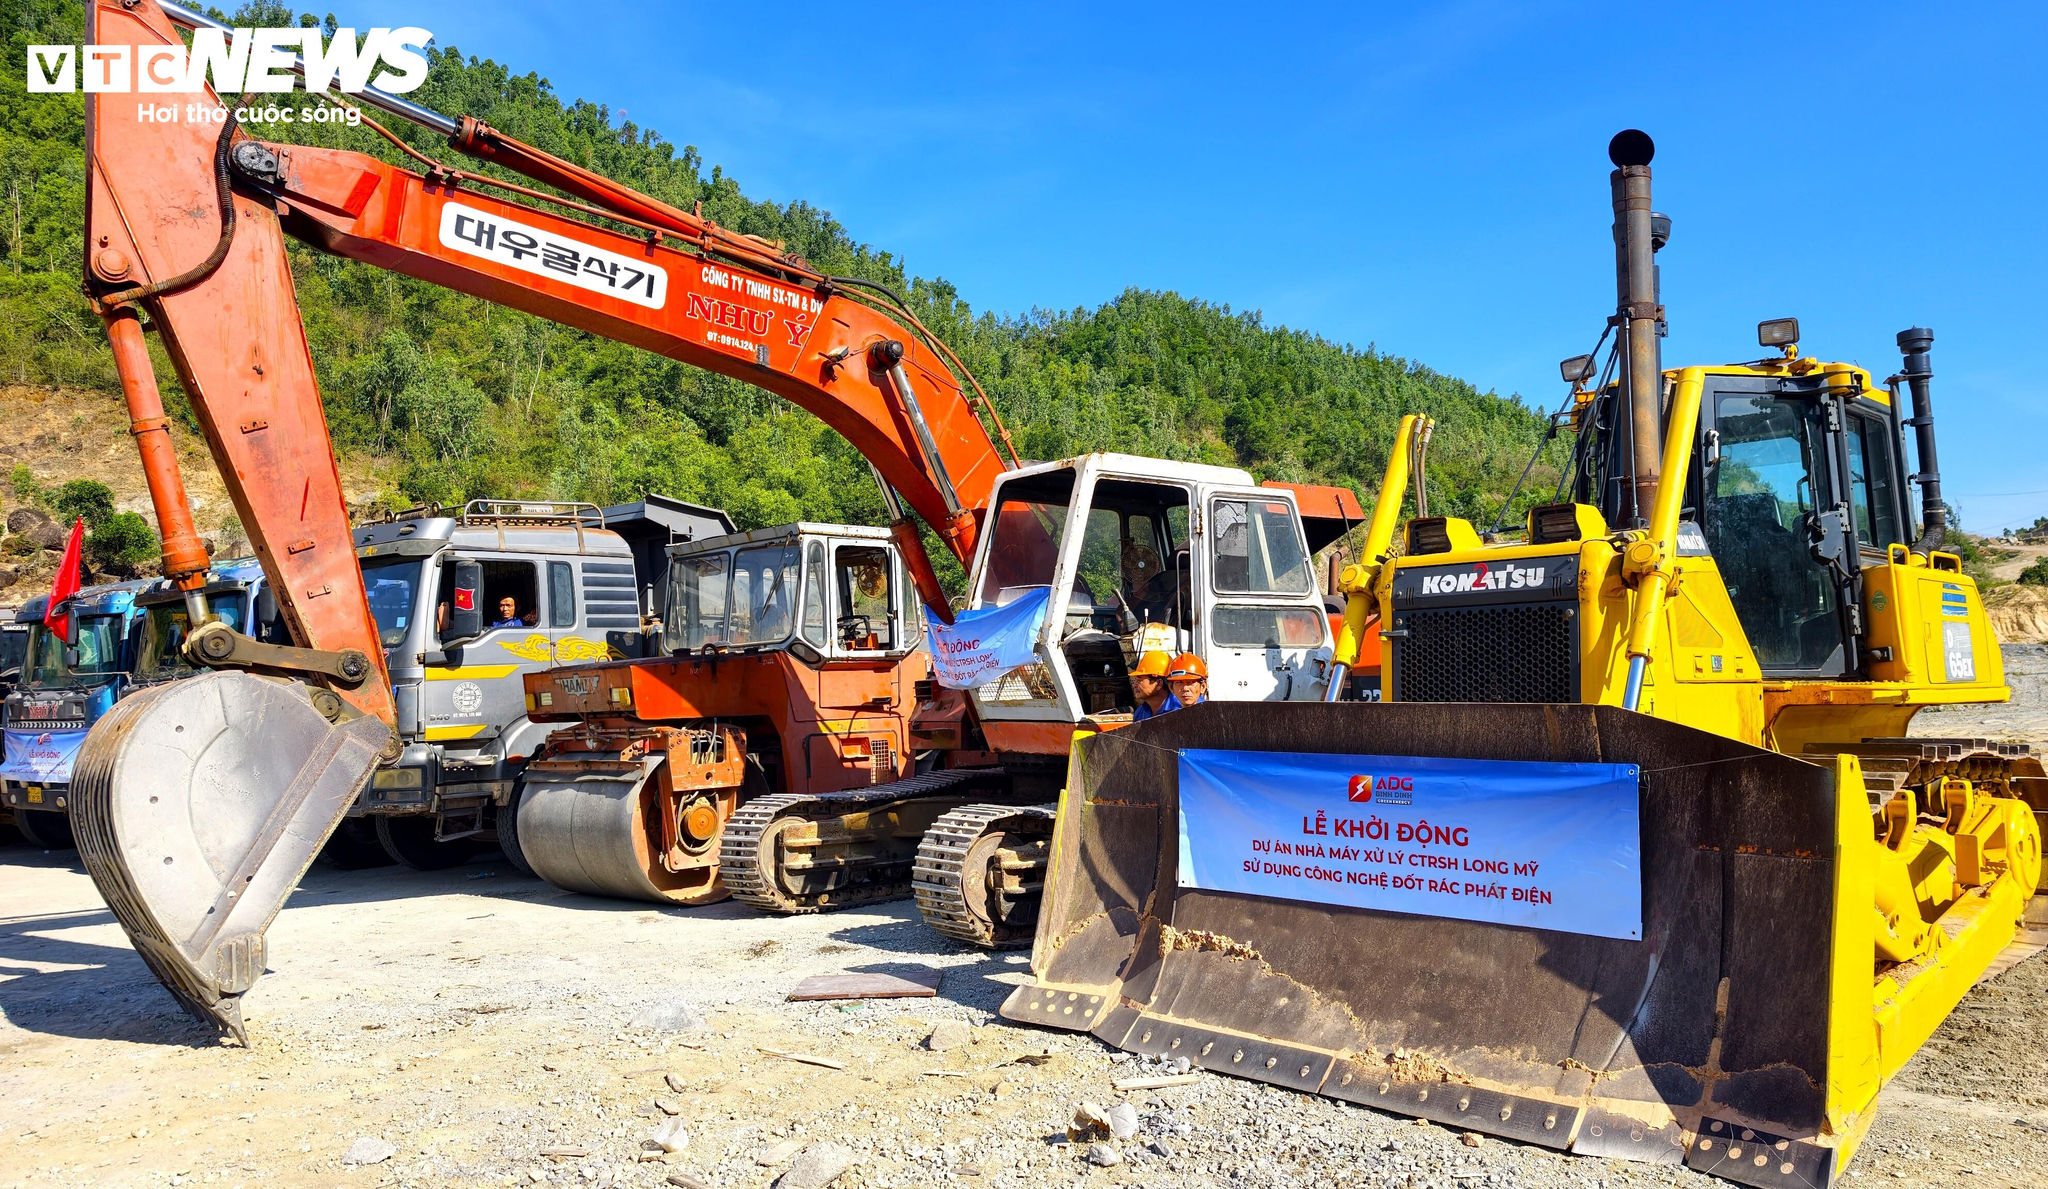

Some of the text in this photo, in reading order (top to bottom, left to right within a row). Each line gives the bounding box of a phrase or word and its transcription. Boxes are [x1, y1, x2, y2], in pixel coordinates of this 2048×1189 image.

[454, 213, 655, 299] 대우굴삭기
[702, 266, 728, 288] CÔNG
[731, 275, 743, 292] TY
[746, 280, 770, 300] TNHH
[801, 296, 808, 311] &
[686, 292, 812, 347] NHƯ Ý
[1422, 564, 1545, 594] KOMATSU
[1946, 629, 1954, 649] D
[1376, 776, 1413, 791] ADG
[1303, 810, 1469, 848] LỄ KHỞI ĐỘNG
[1252, 840, 1539, 877] DỰ ÁN NHÀ MÁY XỬ LÝ CTRSH LONG MỸ
[1243, 857, 1552, 906] SỬ DỤNG CÔNG NGHỆ ĐỐT RÁC PHÁT ĐIỆN
